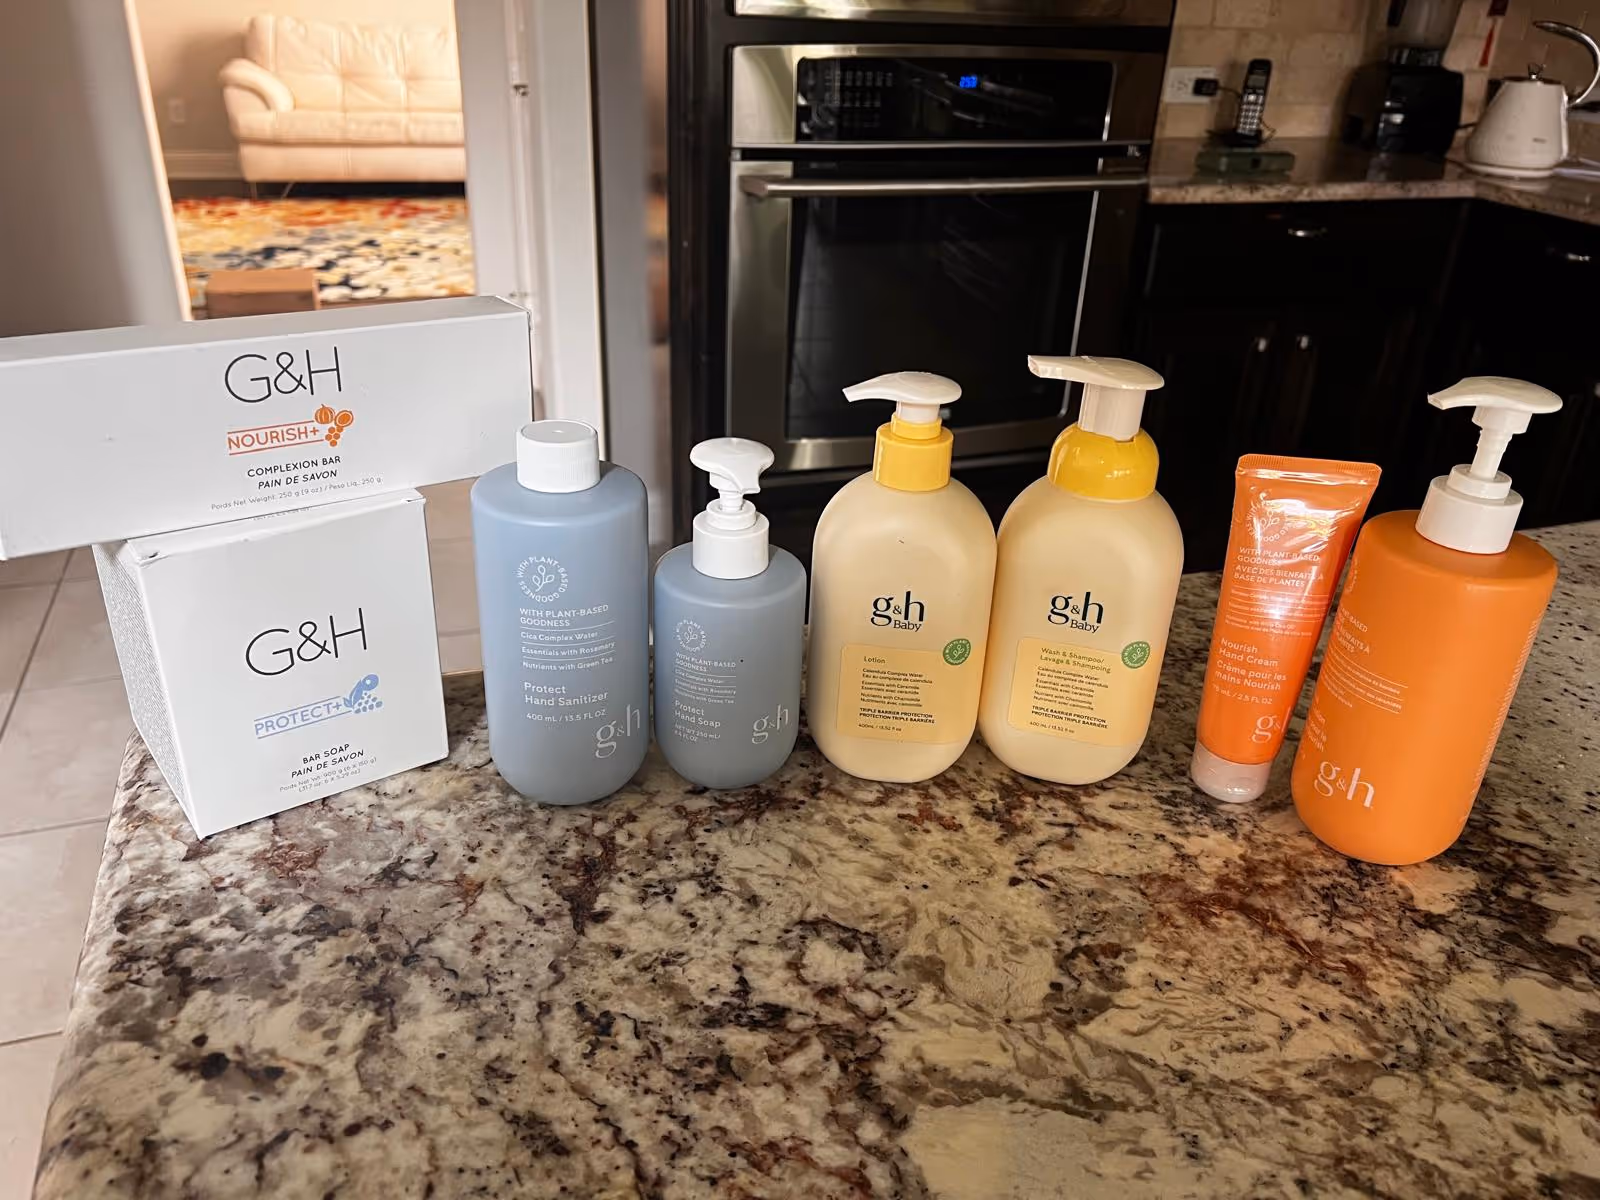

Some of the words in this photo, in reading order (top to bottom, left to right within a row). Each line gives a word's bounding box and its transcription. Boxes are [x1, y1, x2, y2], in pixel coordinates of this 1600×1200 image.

[225, 346, 342, 403] G&H
[227, 426, 320, 450] NOURISH+
[247, 459, 319, 478] COMPLEXION
[322, 455, 341, 465] BAR
[258, 478, 282, 490] PAIN
[285, 475, 299, 485] DE
[302, 469, 338, 482] SAVON
[233, 499, 246, 507] Net
[279, 491, 292, 499] 250
[329, 483, 345, 491] Peso
[362, 477, 375, 485] 250
[1239, 547, 1261, 556] WITH
[1234, 572, 1255, 582] BASE
[1236, 564, 1259, 574] AVEC
[520, 608, 543, 618] WITH
[545, 604, 609, 618] PLANT-BASED
[870, 590, 925, 627] g&h
[1047, 592, 1104, 625] g&h
[520, 617, 570, 627] GOODNESS
[893, 619, 922, 632] Baby
[1070, 619, 1100, 634] Baby
[245, 607, 367, 676] G&H
[520, 632, 537, 640] Cica
[538, 634, 573, 642] Complex
[574, 631, 598, 640] Water
[521, 646, 559, 656] Essentials
[579, 641, 616, 654] Rosemary
[1221, 638, 1258, 654] Nourish
[522, 661, 557, 670] Nutrients
[577, 661, 599, 669] Green
[601, 657, 613, 665] Tea
[864, 656, 886, 664] Lotion
[1041, 647, 1060, 656] Wash
[1069, 652, 1105, 664] Shampoo/
[1219, 648, 1244, 662] Hand
[1246, 655, 1278, 667] Cream
[1040, 655, 1064, 665] Lavage
[1072, 661, 1111, 674] Shampoing
[1215, 671, 1241, 685] mains
[1244, 678, 1281, 691] Nourish
[1248, 670, 1272, 680] pour
[1274, 673, 1287, 681] les
[524, 682, 566, 694] Protect
[1221, 689, 1231, 697] mL
[525, 695, 555, 706] Hand
[558, 692, 608, 707] Sanitizer
[526, 712, 543, 721] 400
[545, 714, 557, 722] mL
[564, 714, 582, 722] 13.5
[583, 712, 593, 720] FL
[594, 709, 607, 717] OZ
[675, 700, 704, 716] Protect
[1031, 710, 1063, 720] PROTECTION
[254, 701, 343, 736] PROTECT+
[675, 710, 696, 723] Hand
[698, 717, 721, 729] Soap
[1073, 713, 1106, 723] PROTECTION
[302, 753, 321, 764] BAR
[323, 743, 350, 758] SOAP
[291, 766, 313, 778] PAIN
[316, 761, 328, 770] DE
[331, 749, 364, 766] SAVON
[1313, 761, 1374, 808] g&h
